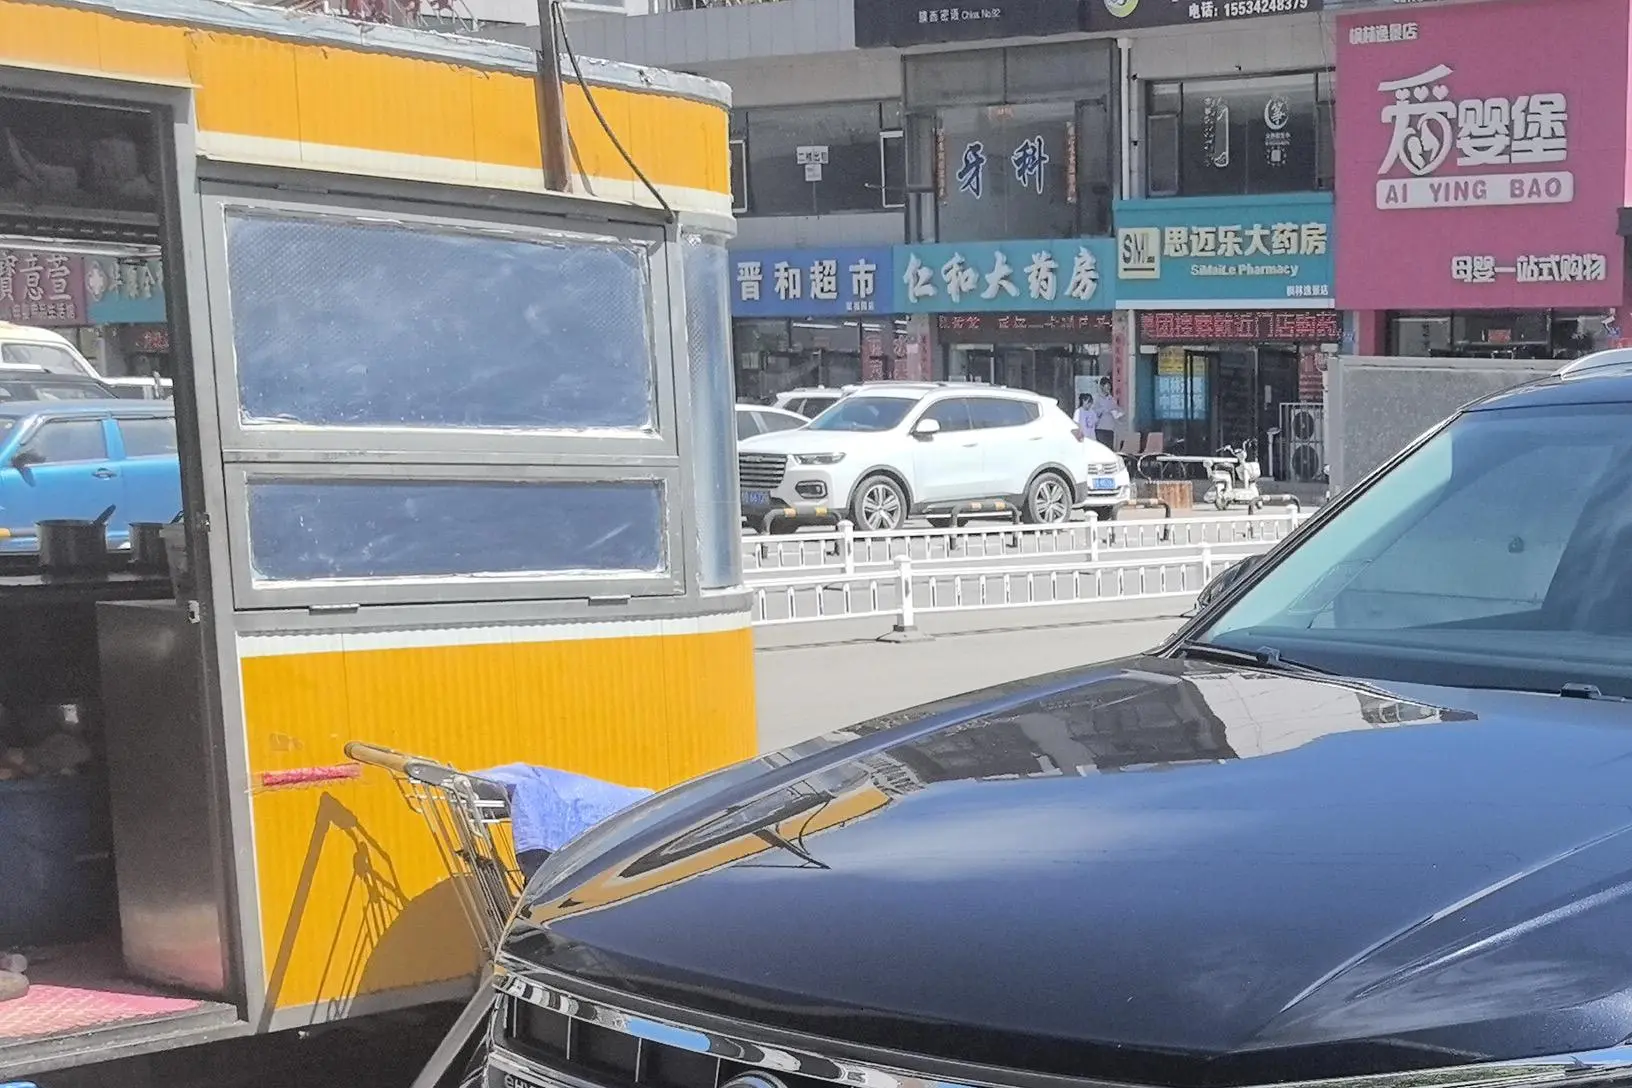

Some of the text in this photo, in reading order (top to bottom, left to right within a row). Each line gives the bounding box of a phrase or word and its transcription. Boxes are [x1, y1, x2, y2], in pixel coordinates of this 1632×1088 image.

[956, 135, 1050, 199] 牙科
[1385, 177, 1563, 205] AI YING BAO
[1163, 222, 1328, 257] 思迈乐大药房
[737, 258, 876, 301] 晋和超市
[903, 246, 1099, 303] 仁和大药房
[1238, 262, 1299, 277] Pharmacy
[1451, 254, 1607, 284] 母婴一站式购物
